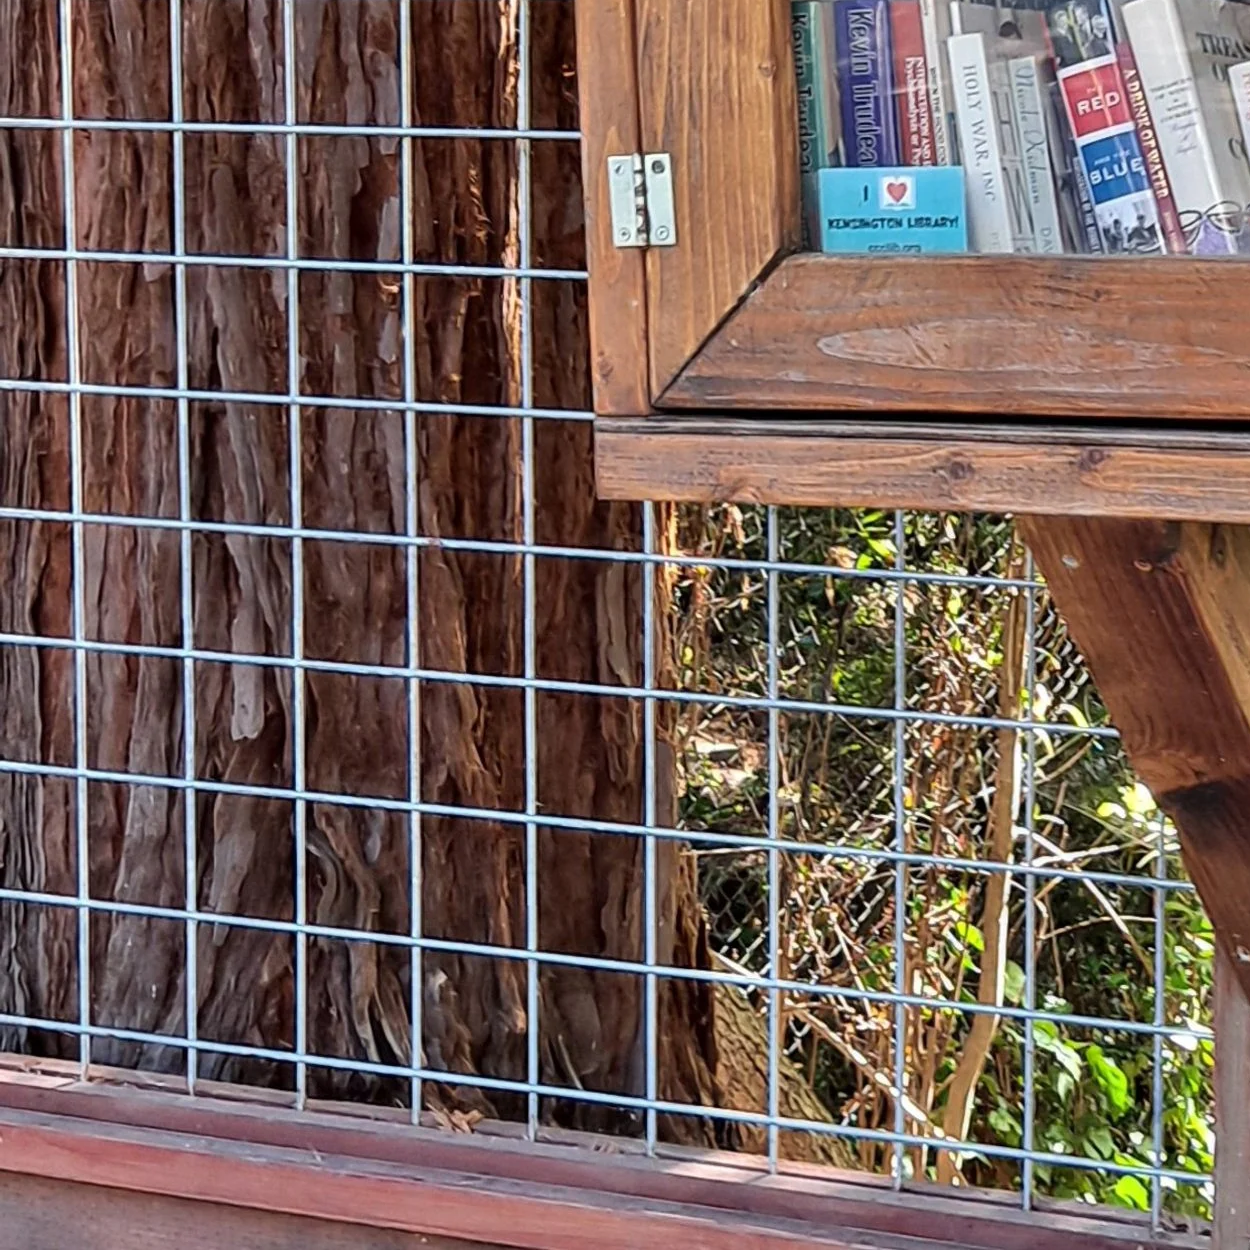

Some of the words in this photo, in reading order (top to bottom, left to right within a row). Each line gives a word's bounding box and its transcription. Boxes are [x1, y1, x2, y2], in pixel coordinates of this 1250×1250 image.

[848, 7, 877, 77] Kevin
[962, 65, 982, 111] HOLY
[1015, 65, 1039, 122] Nicole
[1124, 69, 1138, 79] A
[852, 80, 881, 167] Trudea
[1076, 91, 1120, 117] RED
[1126, 80, 1152, 130] DRINK
[799, 85, 817, 175] Trudea
[971, 120, 990, 167] WAR,
[1023, 129, 1047, 204] Kidman
[1089, 156, 1144, 186] BLUE
[1146, 149, 1170, 199] WATER
[863, 184, 868, 203] I
[827, 217, 903, 230] KENSINGTON
